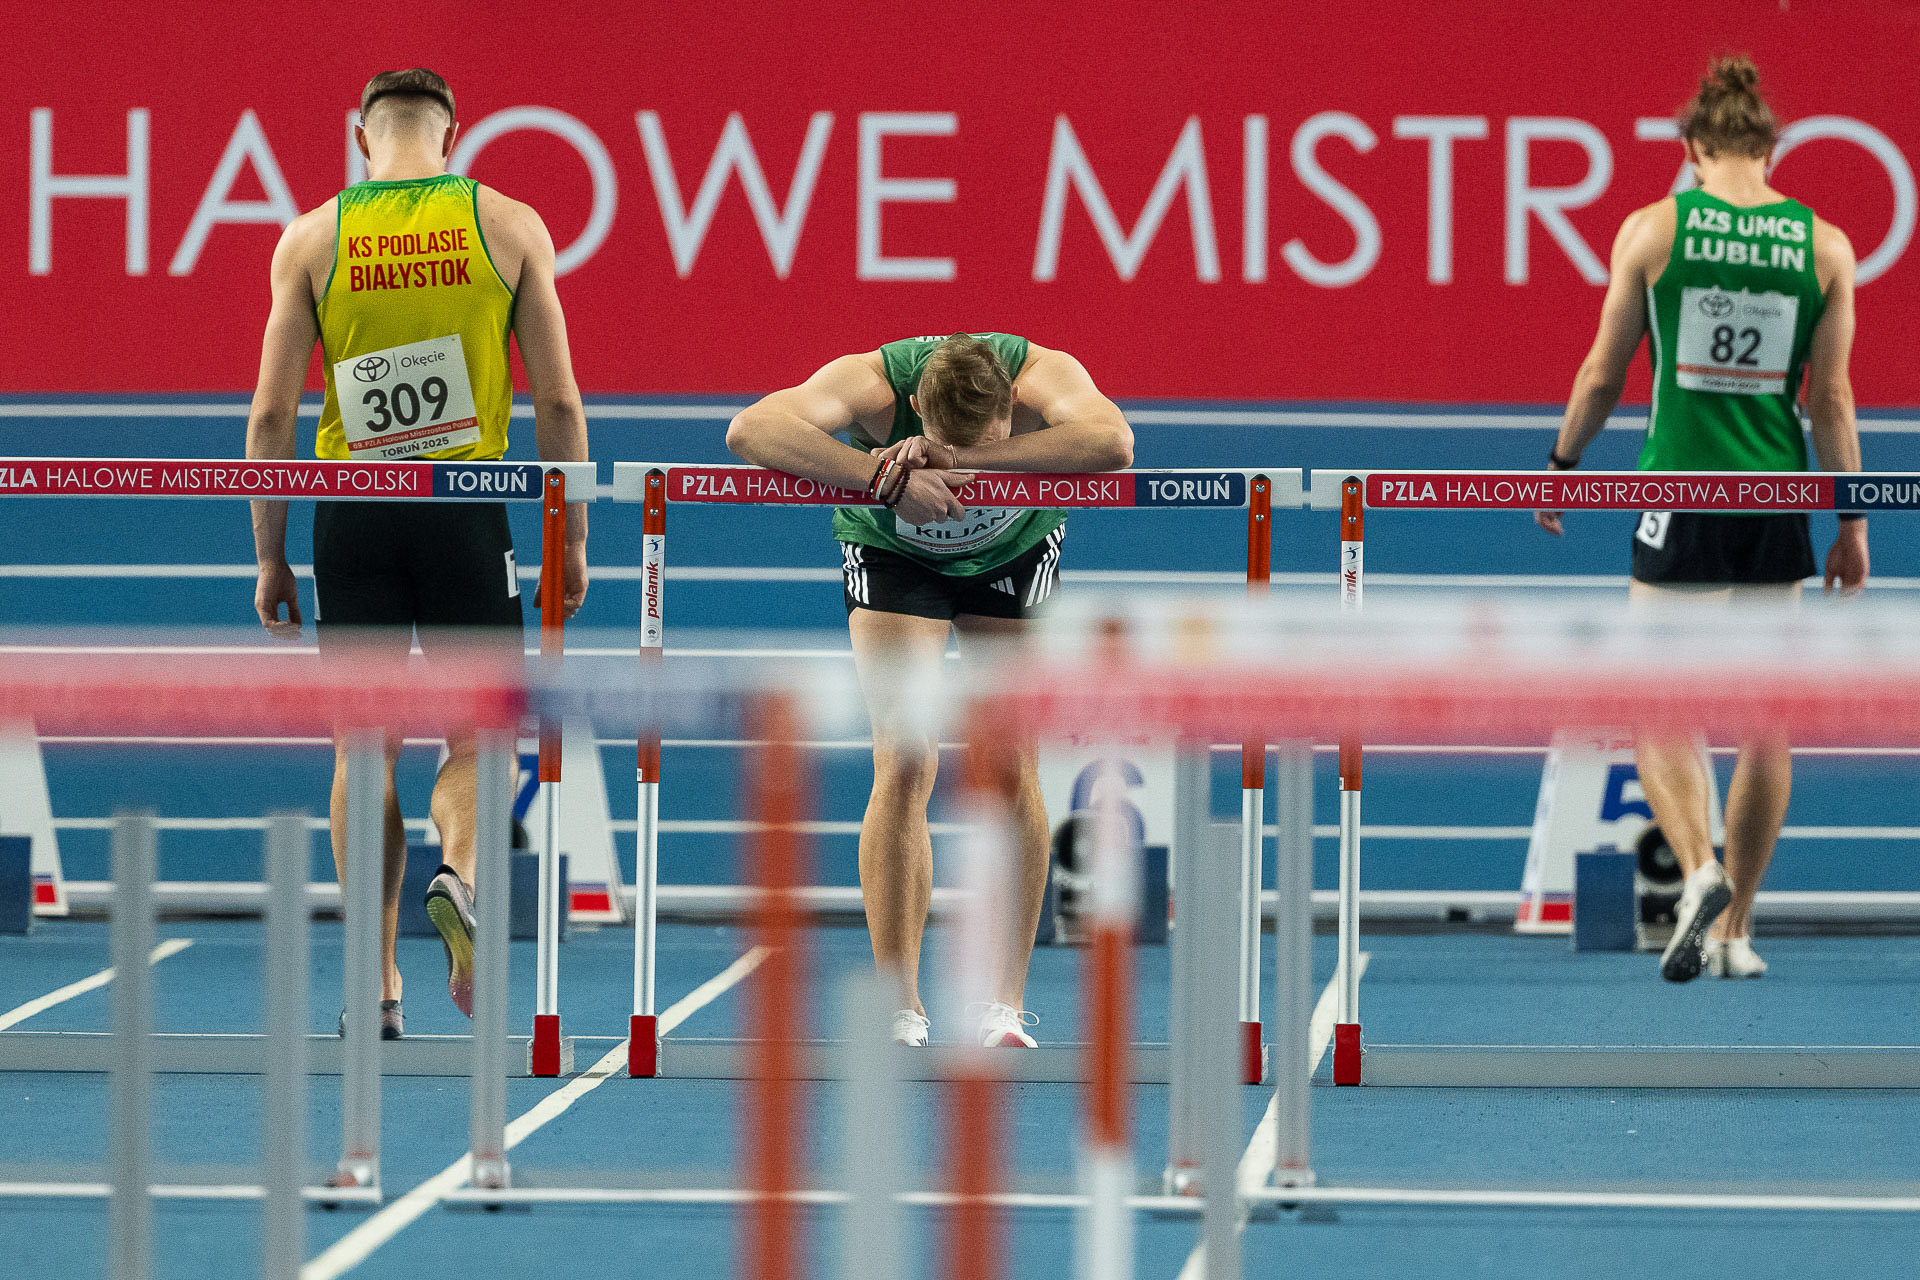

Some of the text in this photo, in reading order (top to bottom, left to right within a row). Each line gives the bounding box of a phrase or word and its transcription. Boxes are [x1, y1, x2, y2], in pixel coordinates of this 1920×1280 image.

[1031, 110, 1919, 289] MISTRO
[1686, 206, 1807, 243] AZS UMCS
[348, 228, 469, 258] KS PODLASIE
[1684, 236, 1806, 272] LUBLIN
[350, 257, 472, 292] BIAŁYSTOK
[400, 351, 446, 368] Okęcie
[1709, 323, 1762, 366] 82
[362, 376, 449, 433] 309
[365, 440, 382, 448] PZLA
[382, 433, 409, 444] Halowe
[409, 425, 452, 440] Mistrzostwa
[381, 437, 450, 458] TORUŃ 2025
[46, 467, 153, 489] HALOWE
[160, 468, 328, 490] MISTRZOSTWA
[337, 470, 418, 491] POLSKI
[446, 466, 528, 492] TORUŃ
[682, 475, 738, 496] PZLA
[1039, 480, 1120, 501] POLSKI
[1149, 473, 1230, 501] TORUŃ
[1381, 481, 1438, 501] PZLA
[1446, 481, 1553, 503] HALOWE
[1561, 482, 1730, 503] MISTRZOSTWA
[1738, 483, 1819, 503] POLSKI
[915, 509, 1007, 540] KILJAN
[646, 561, 660, 619] polanik
